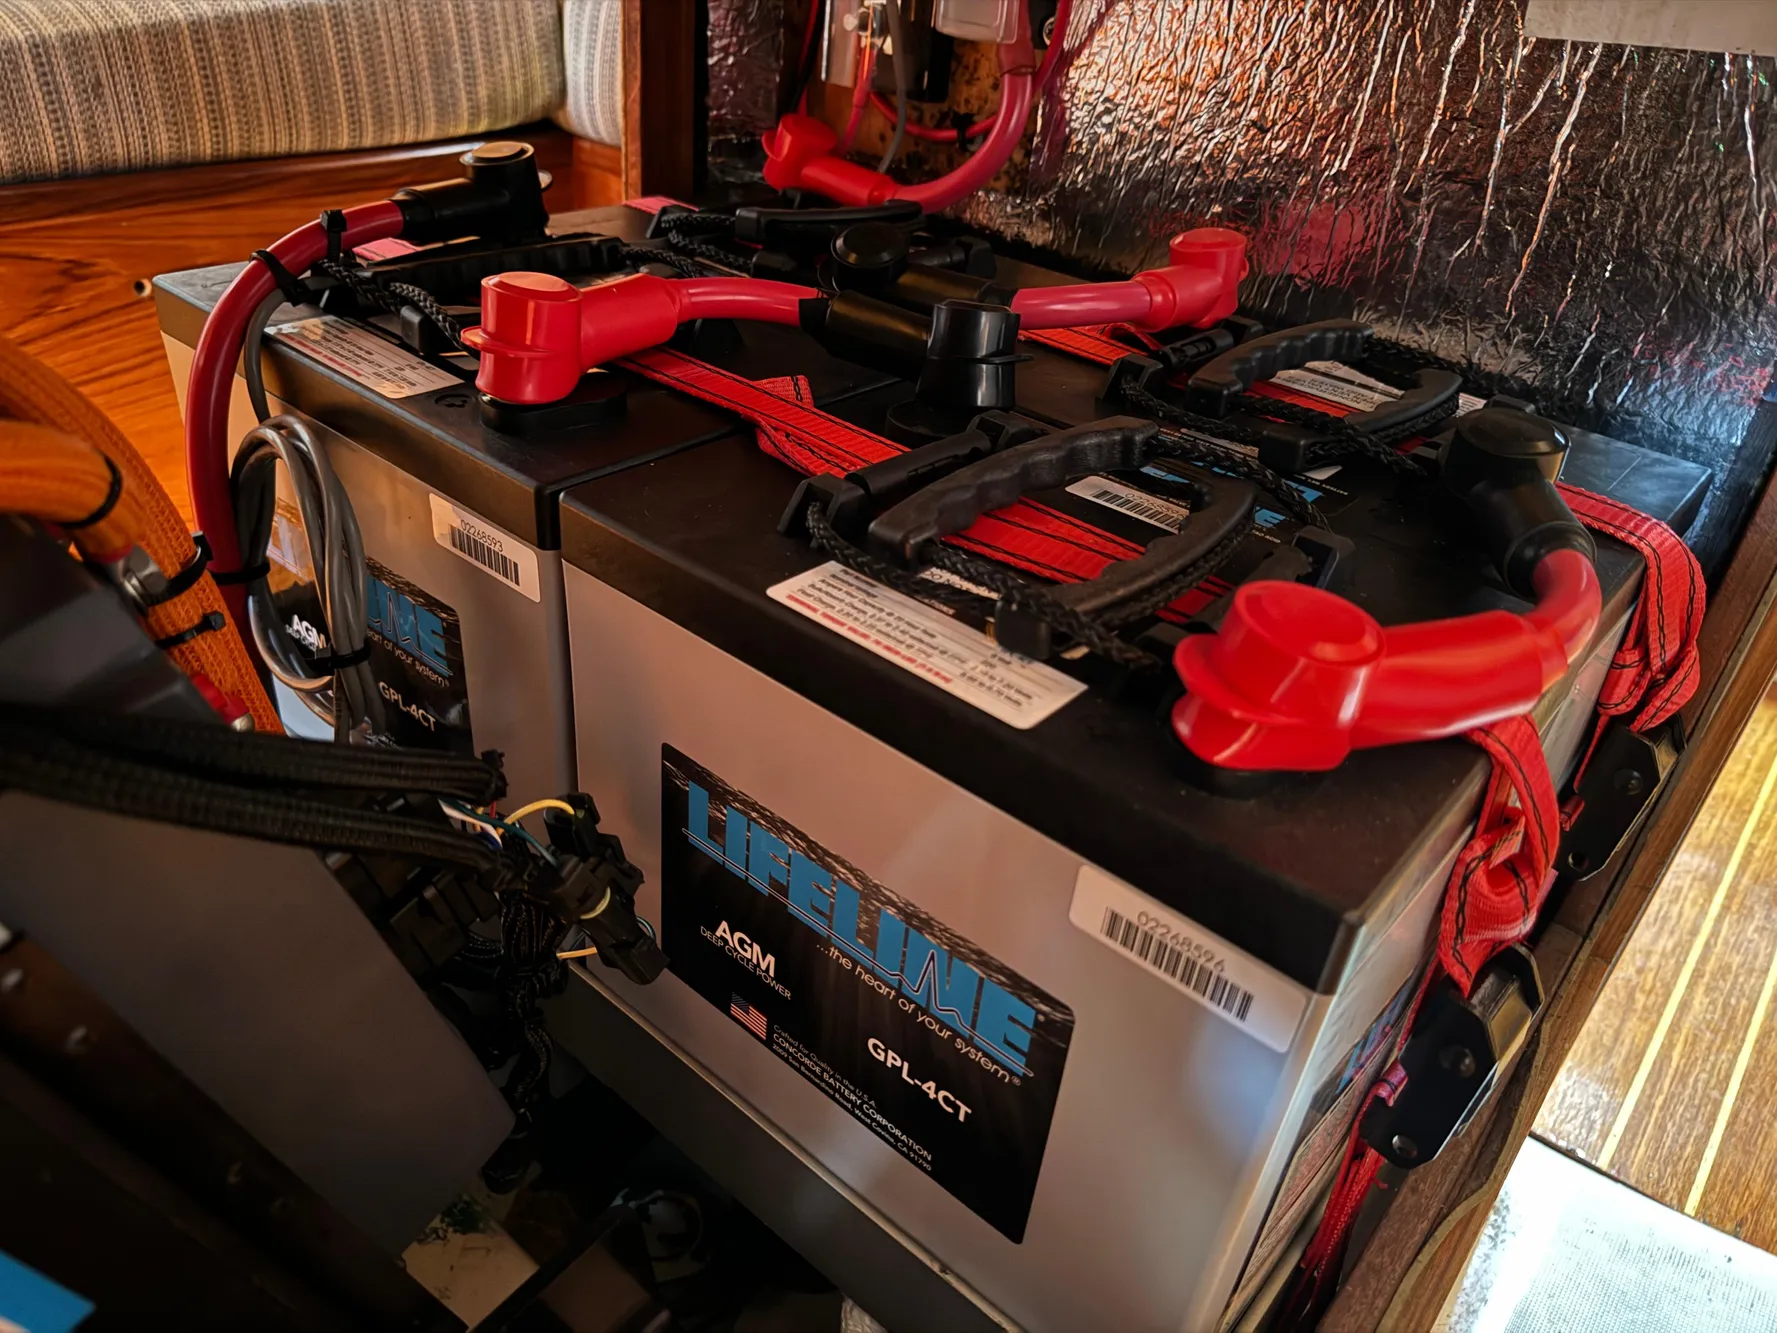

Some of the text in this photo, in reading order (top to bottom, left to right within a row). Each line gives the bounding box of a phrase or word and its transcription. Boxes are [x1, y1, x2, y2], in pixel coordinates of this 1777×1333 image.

[460, 519, 504, 553] 02268593
[291, 613, 327, 650] AGM
[394, 649, 413, 666] your
[378, 681, 437, 732] GPL-4CT
[686, 780, 1038, 1077] LIFELINE
[715, 920, 776, 978] AGM
[1136, 910, 1225, 974] 02268596
[700, 925, 791, 1000] DEEP CYCLE POWER
[855, 965, 896, 1000] heart
[898, 998, 916, 1014] of
[916, 1010, 952, 1040] your
[773, 1024, 799, 1048] Crafted
[800, 1043, 809, 1054] for
[810, 1052, 834, 1075] Quality
[835, 1072, 842, 1081] in
[843, 1078, 855, 1091] the
[867, 1037, 972, 1123] GPL-4CT
[773, 1033, 932, 1161] CONCORDE BATTERY CORPORATION
[854, 1107, 871, 1125] West
[897, 1141, 909, 1154] CA
[909, 1151, 932, 1171] 91790
